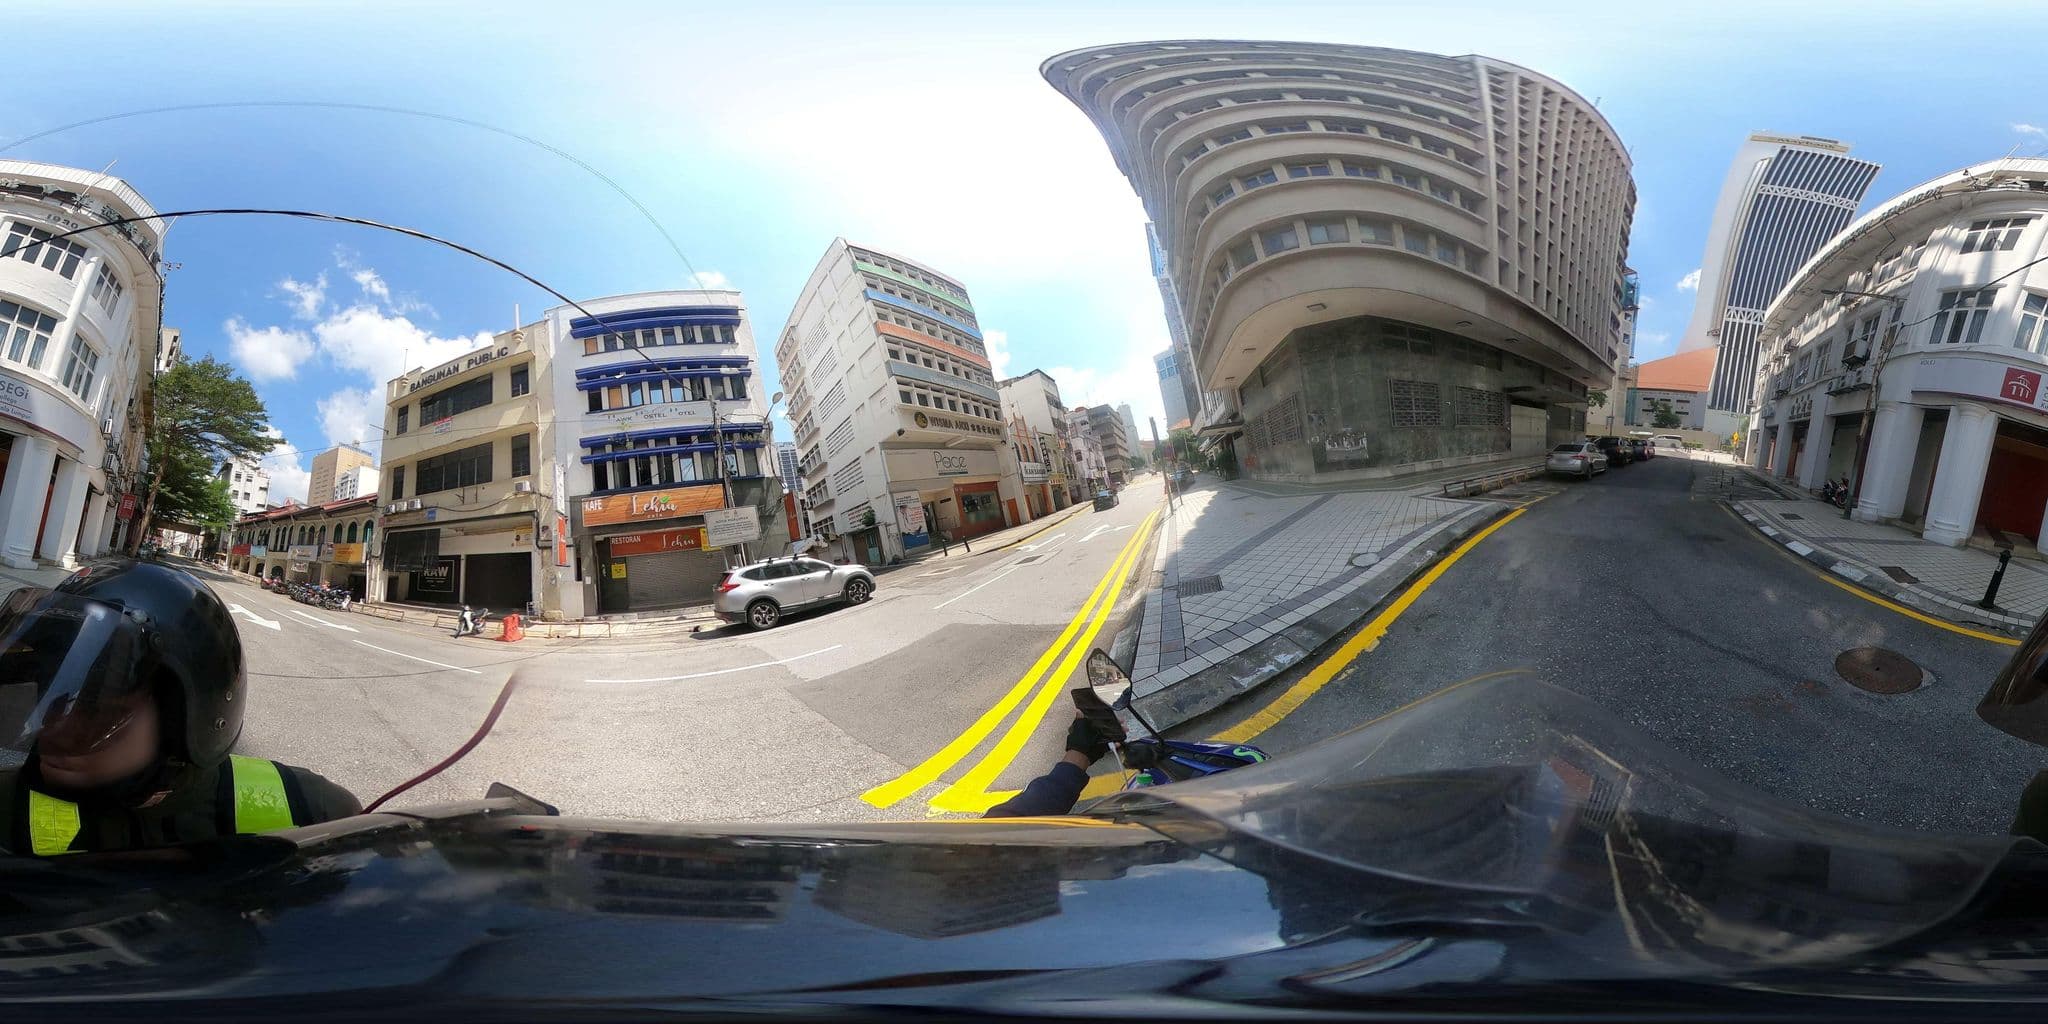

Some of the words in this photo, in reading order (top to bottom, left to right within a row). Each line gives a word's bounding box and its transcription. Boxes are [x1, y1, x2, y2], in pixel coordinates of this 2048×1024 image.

[409, 363, 460, 393] BANGUNAN
[467, 346, 509, 369] PUBLIC
[933, 450, 968, 469] Pace
[584, 499, 603, 512] KAFE
